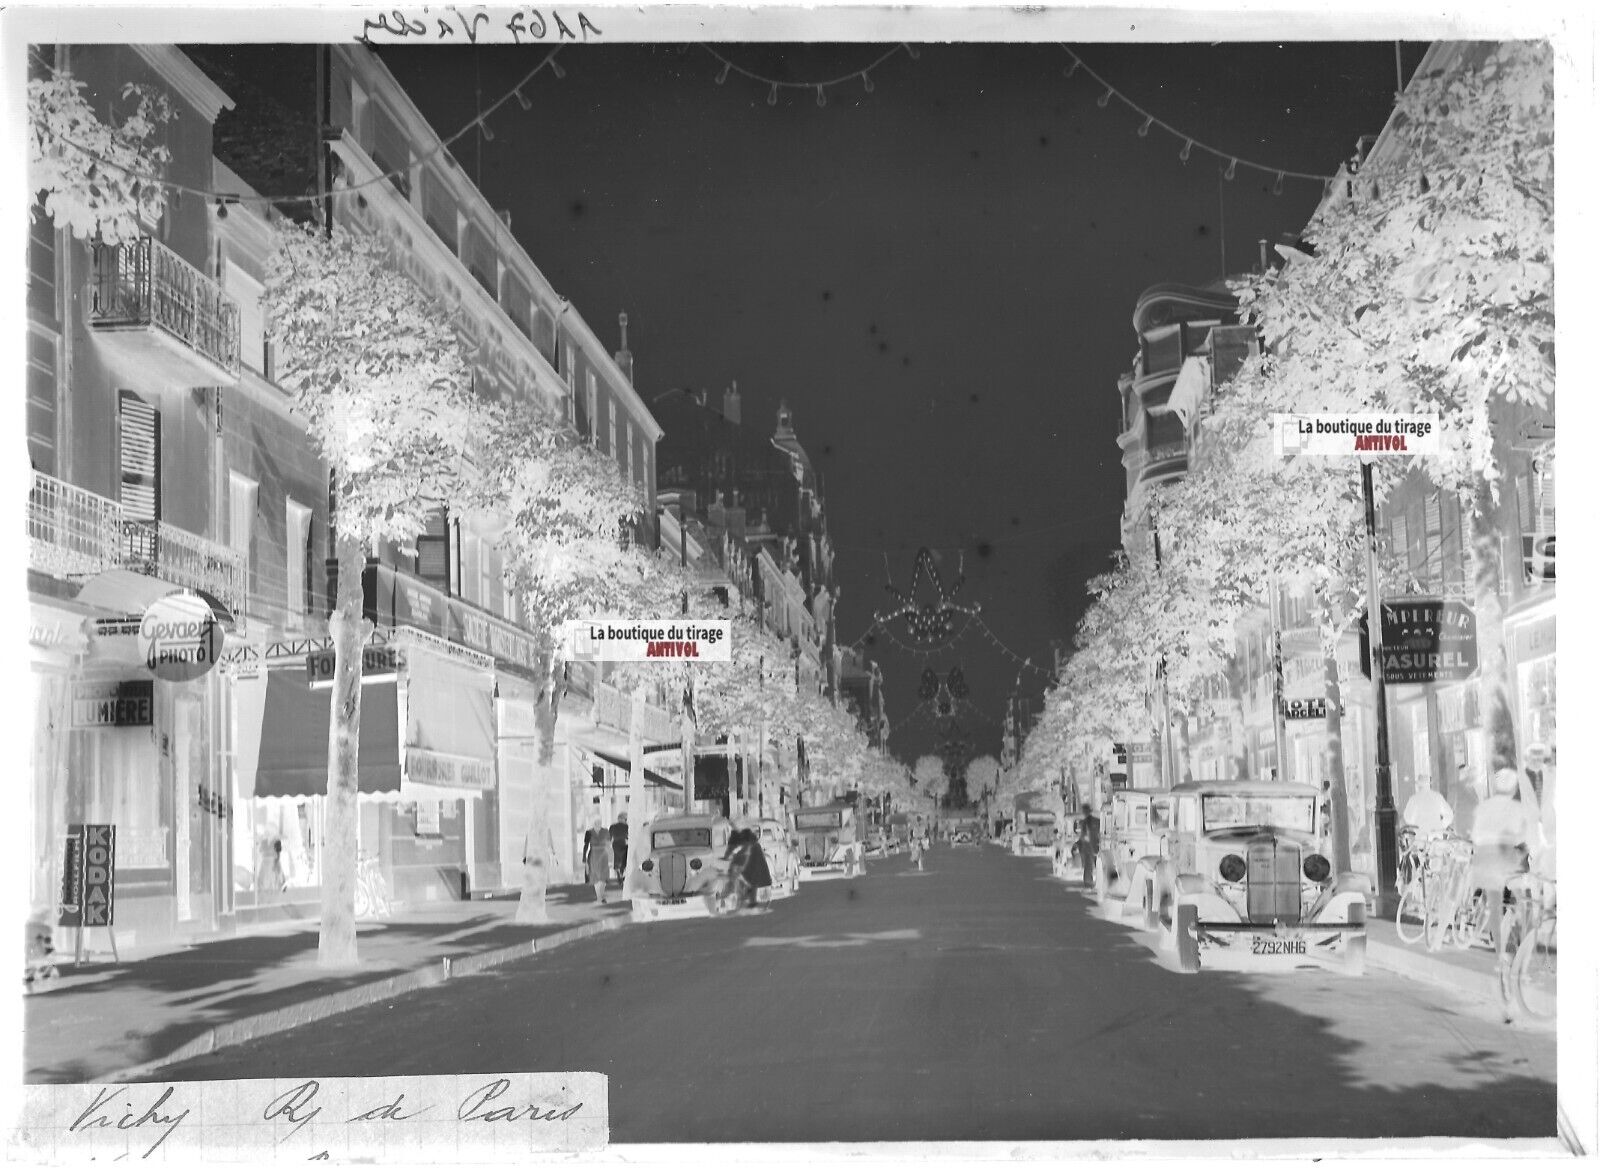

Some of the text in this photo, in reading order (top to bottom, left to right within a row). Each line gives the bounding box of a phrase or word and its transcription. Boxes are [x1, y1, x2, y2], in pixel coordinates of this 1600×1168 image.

[141, 613, 219, 671] Gevaert
[159, 647, 206, 665] PHOTO
[87, 827, 108, 924] KODAK
[69, 1085, 191, 1160] Vichy
[458, 1079, 584, 1123] Paris
